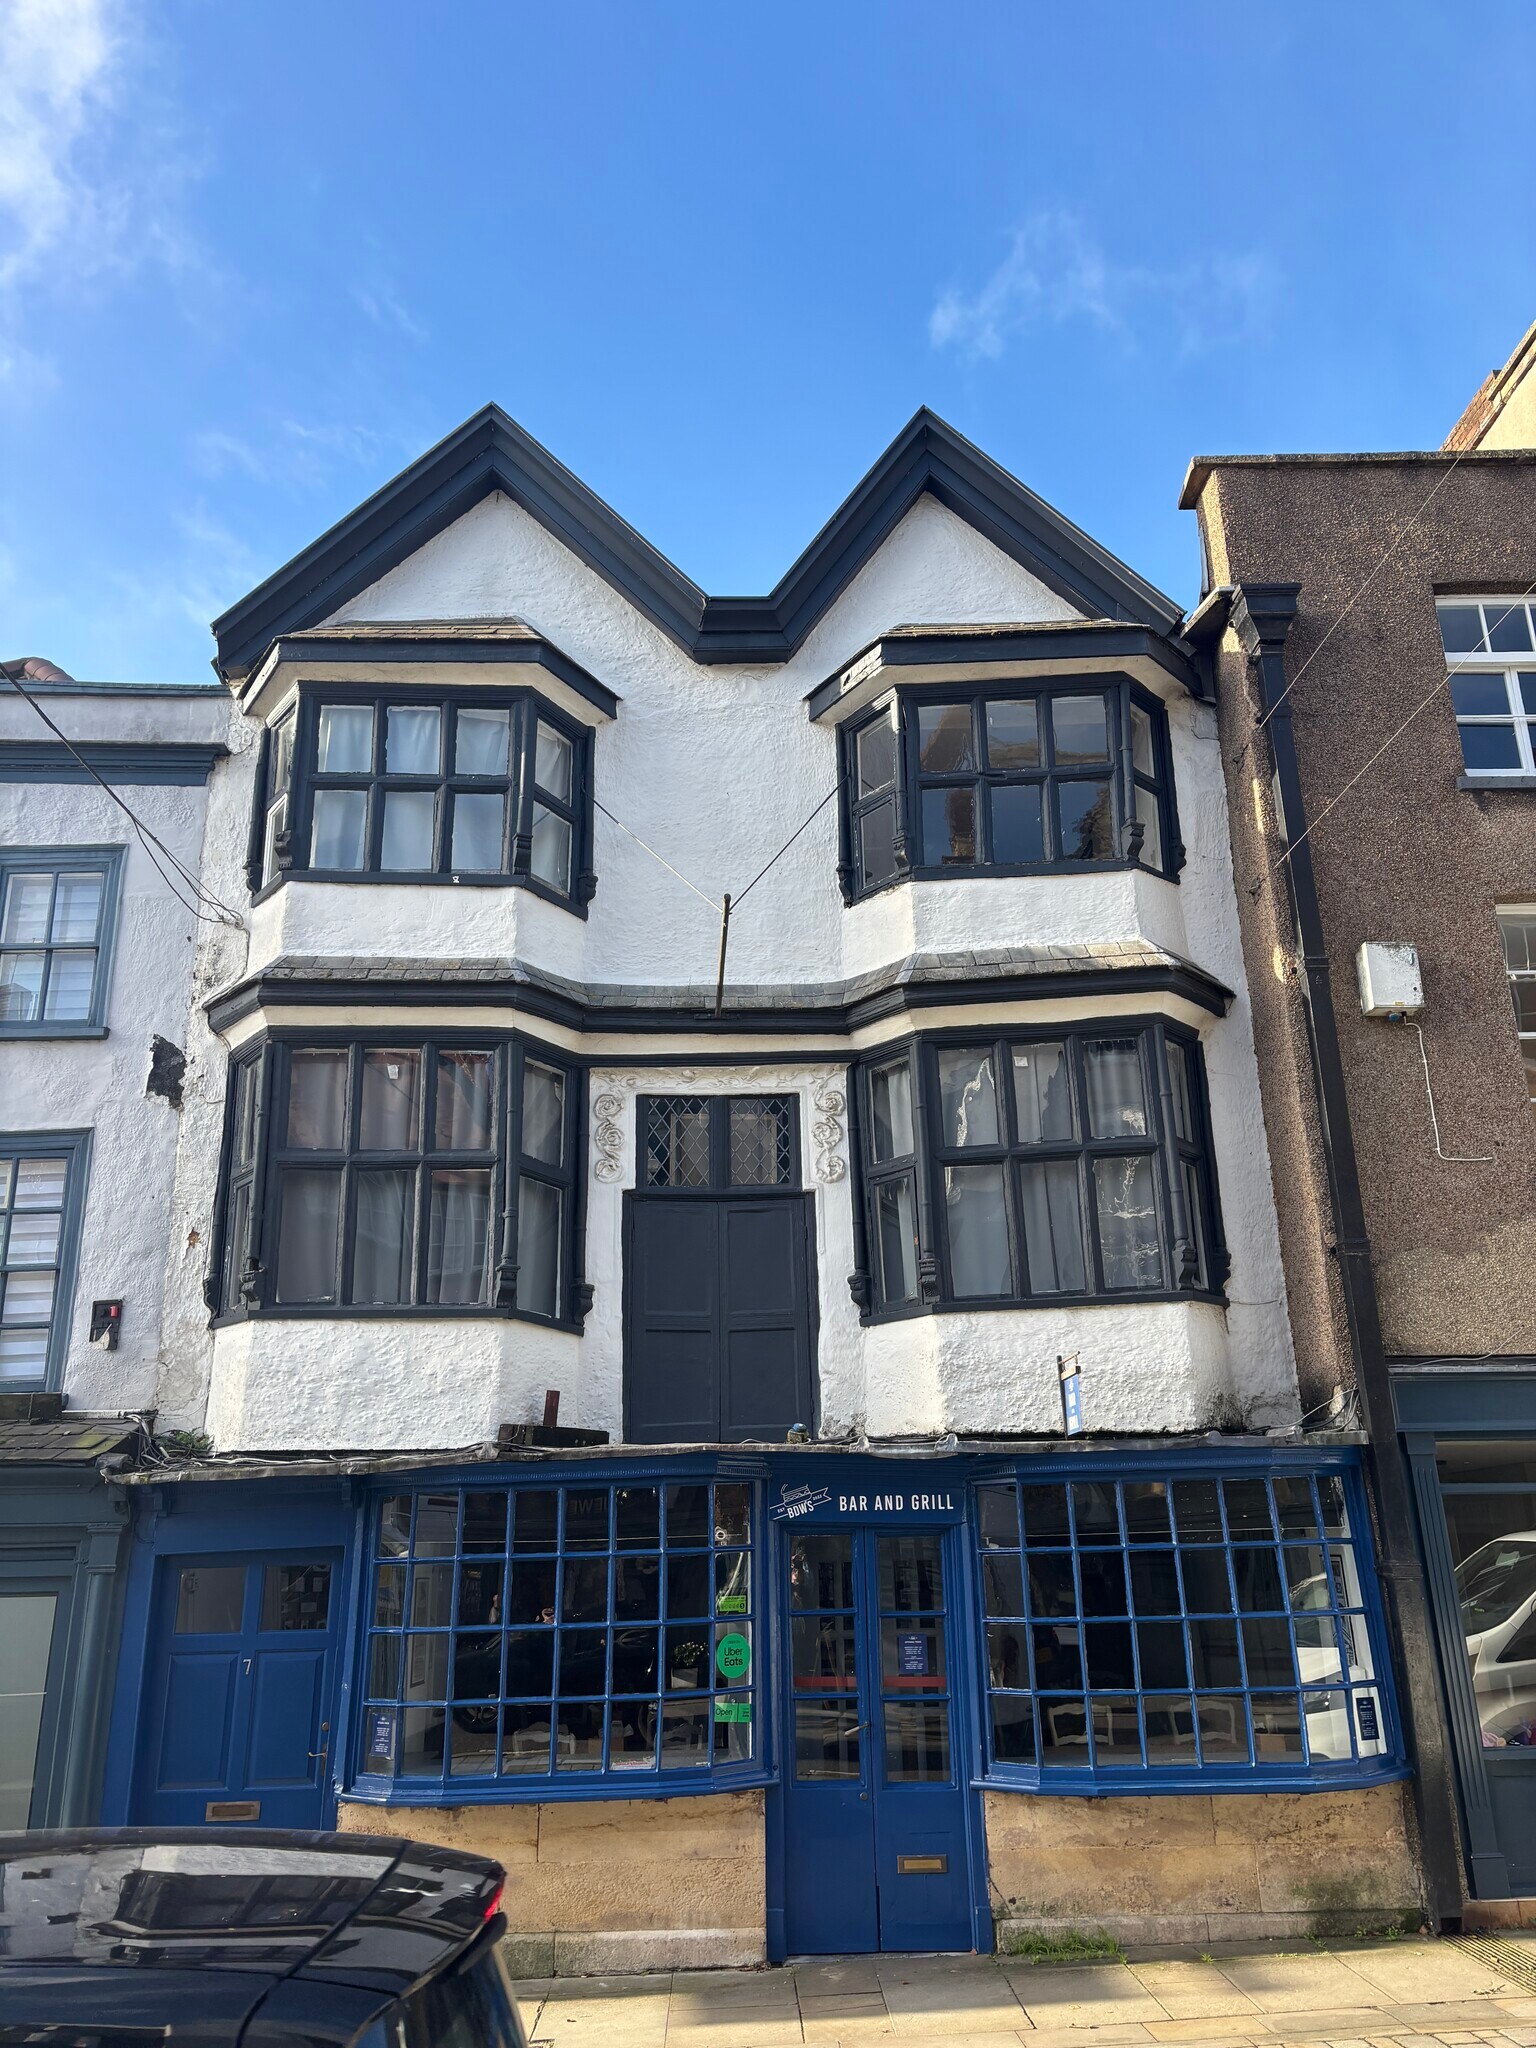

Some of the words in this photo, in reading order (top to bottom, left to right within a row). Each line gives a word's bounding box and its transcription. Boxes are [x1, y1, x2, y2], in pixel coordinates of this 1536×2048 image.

[839, 1495, 868, 1511] BAR
[875, 1495, 904, 1511] AND
[911, 1494, 954, 1510] GRILL
[724, 1647, 743, 1656] Uber
[724, 1657, 743, 1666] Eats
[242, 1658, 252, 1675] 7
[715, 1708, 733, 1717] Open
